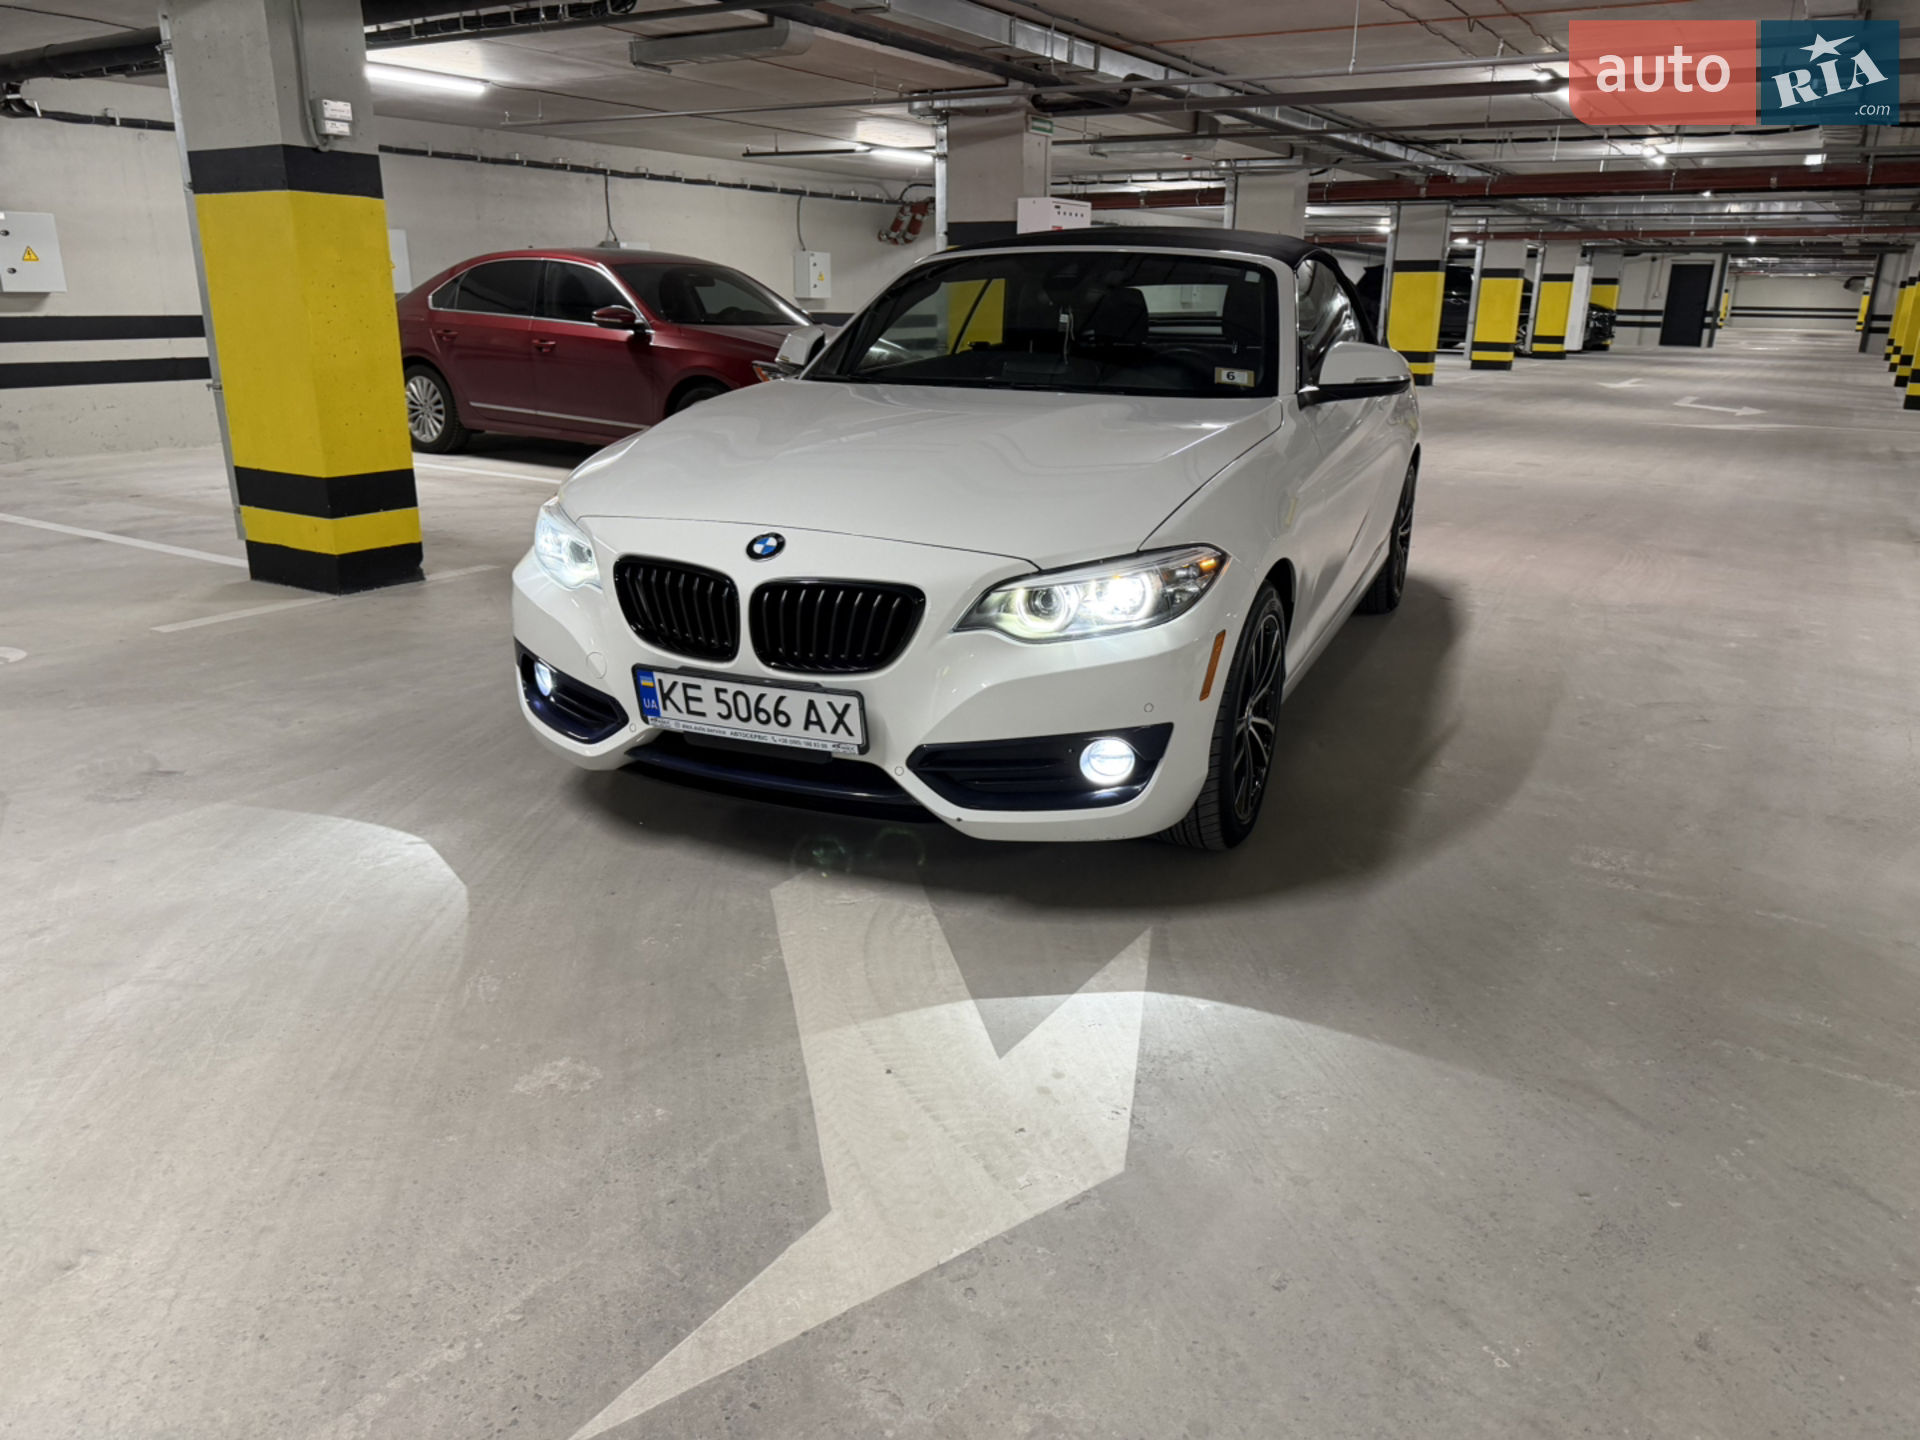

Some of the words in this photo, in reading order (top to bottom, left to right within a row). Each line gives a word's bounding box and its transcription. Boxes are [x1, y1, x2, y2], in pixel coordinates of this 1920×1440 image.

[1226, 371, 1235, 381] 6
[643, 698, 659, 710] UA
[657, 678, 707, 717] KE
[714, 687, 792, 728] 5066
[803, 699, 855, 737] AX
